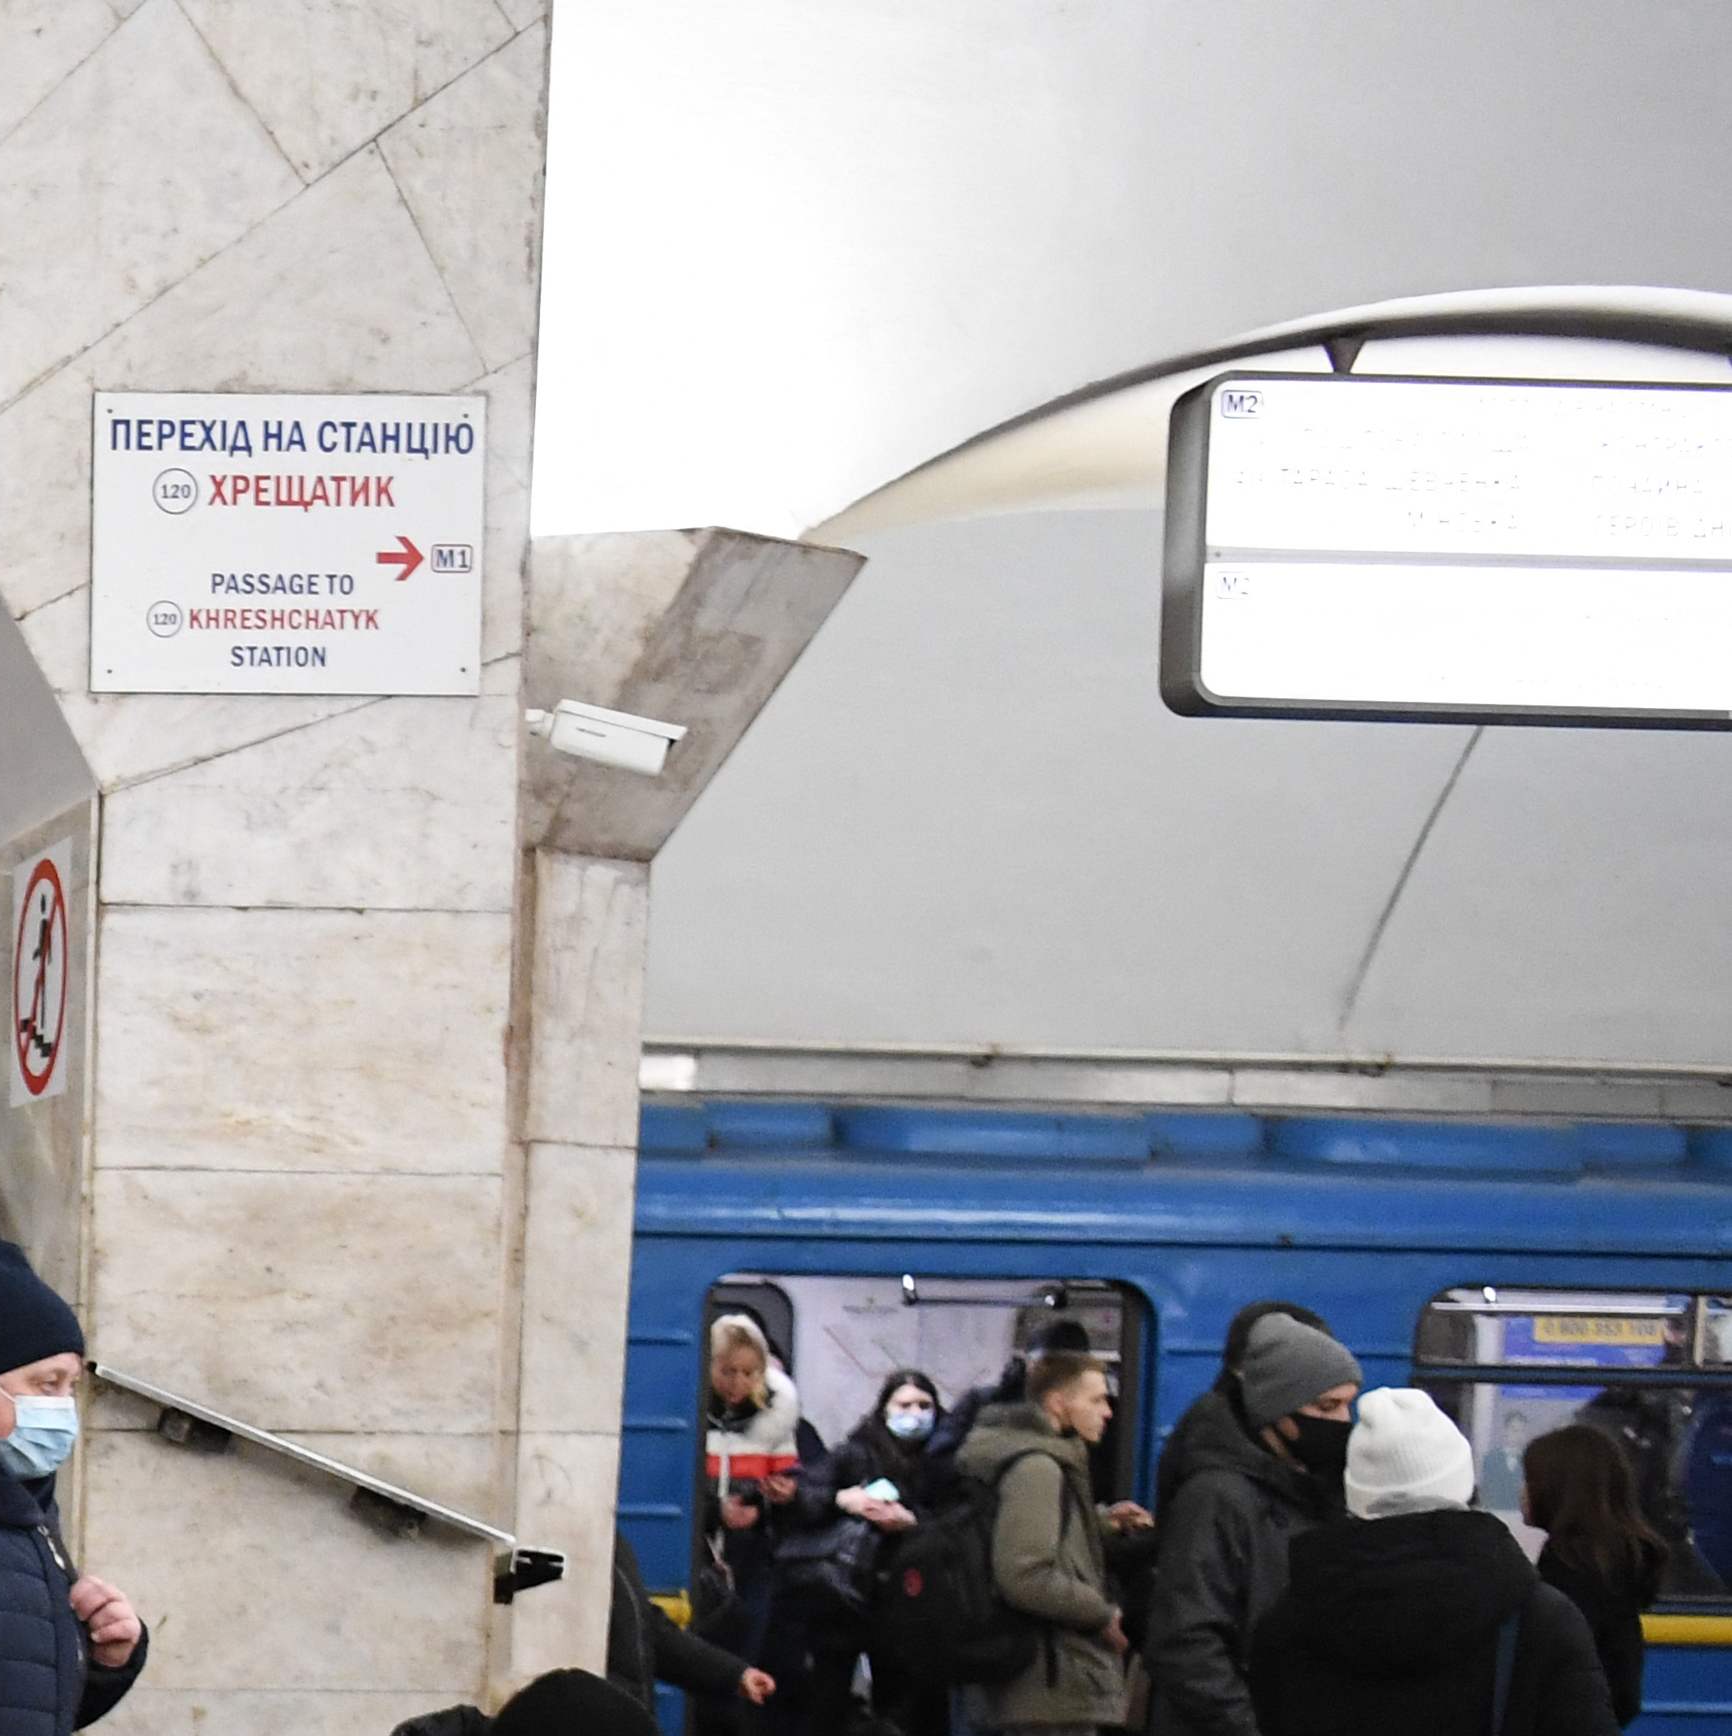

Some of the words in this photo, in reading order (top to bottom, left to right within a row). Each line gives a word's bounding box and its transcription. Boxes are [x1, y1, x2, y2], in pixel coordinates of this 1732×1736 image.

[111, 418, 253, 457] ПЕРЕХІД
[263, 420, 307, 454] НА
[318, 421, 475, 460] СТАНЦІЮ
[160, 483, 192, 500] 120
[208, 474, 396, 513] ХРЕЩАТИК
[211, 573, 317, 596] PASSAGE
[327, 574, 354, 596] TO
[153, 612, 178, 627] 120
[189, 608, 380, 631] KHRESHCHATYK
[230, 646, 327, 668] STATION
